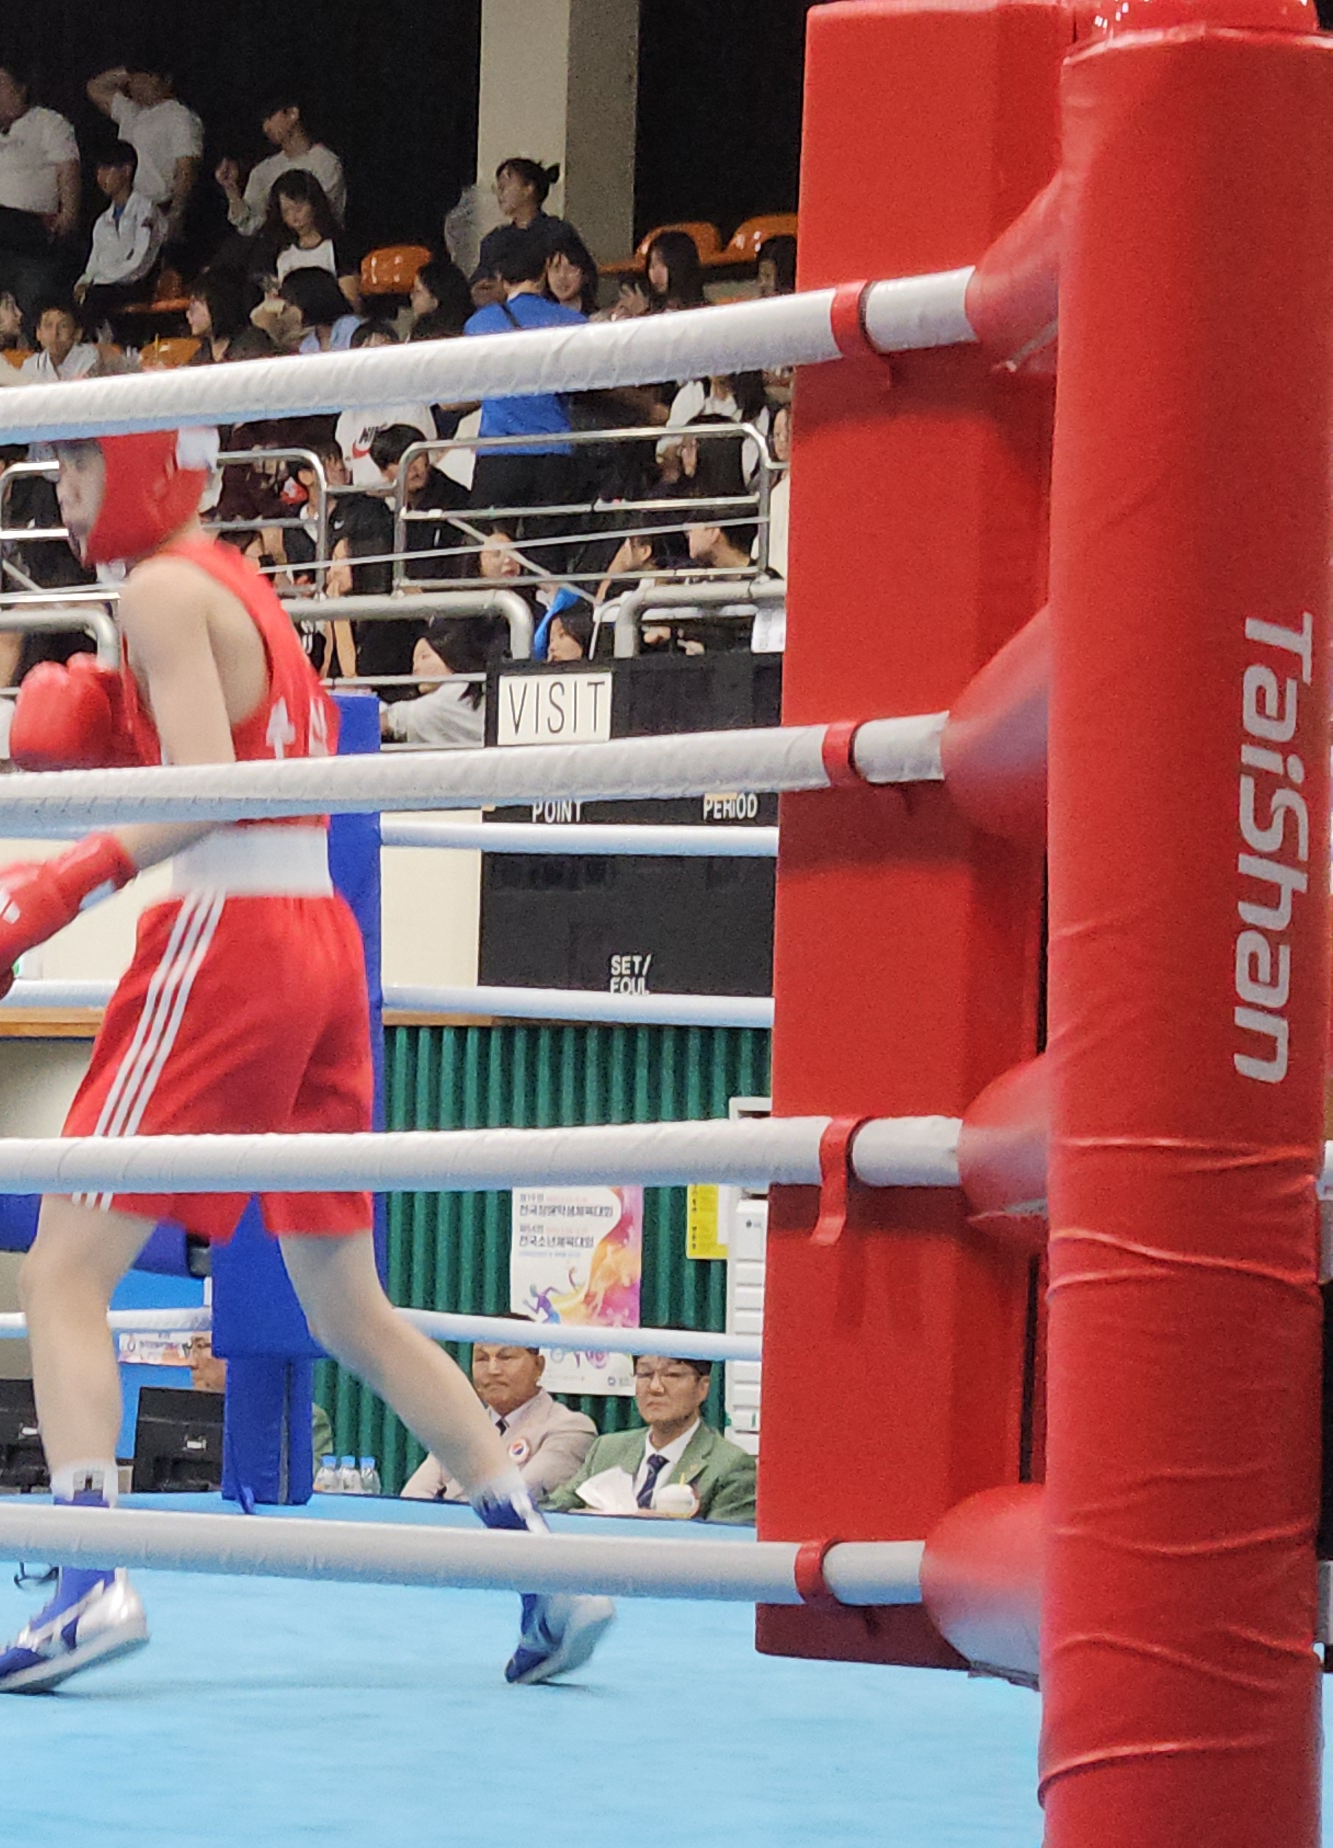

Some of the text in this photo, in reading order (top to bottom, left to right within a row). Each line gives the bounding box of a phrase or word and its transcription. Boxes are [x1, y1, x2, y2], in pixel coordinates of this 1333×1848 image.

[508, 680, 605, 735] VISIT
[532, 799, 583, 823] POINT
[703, 793, 758, 820] PERIOD
[1233, 612, 1313, 1084] TaiShan
[610, 953, 652, 976] SET/
[609, 975, 651, 995] FOUL
